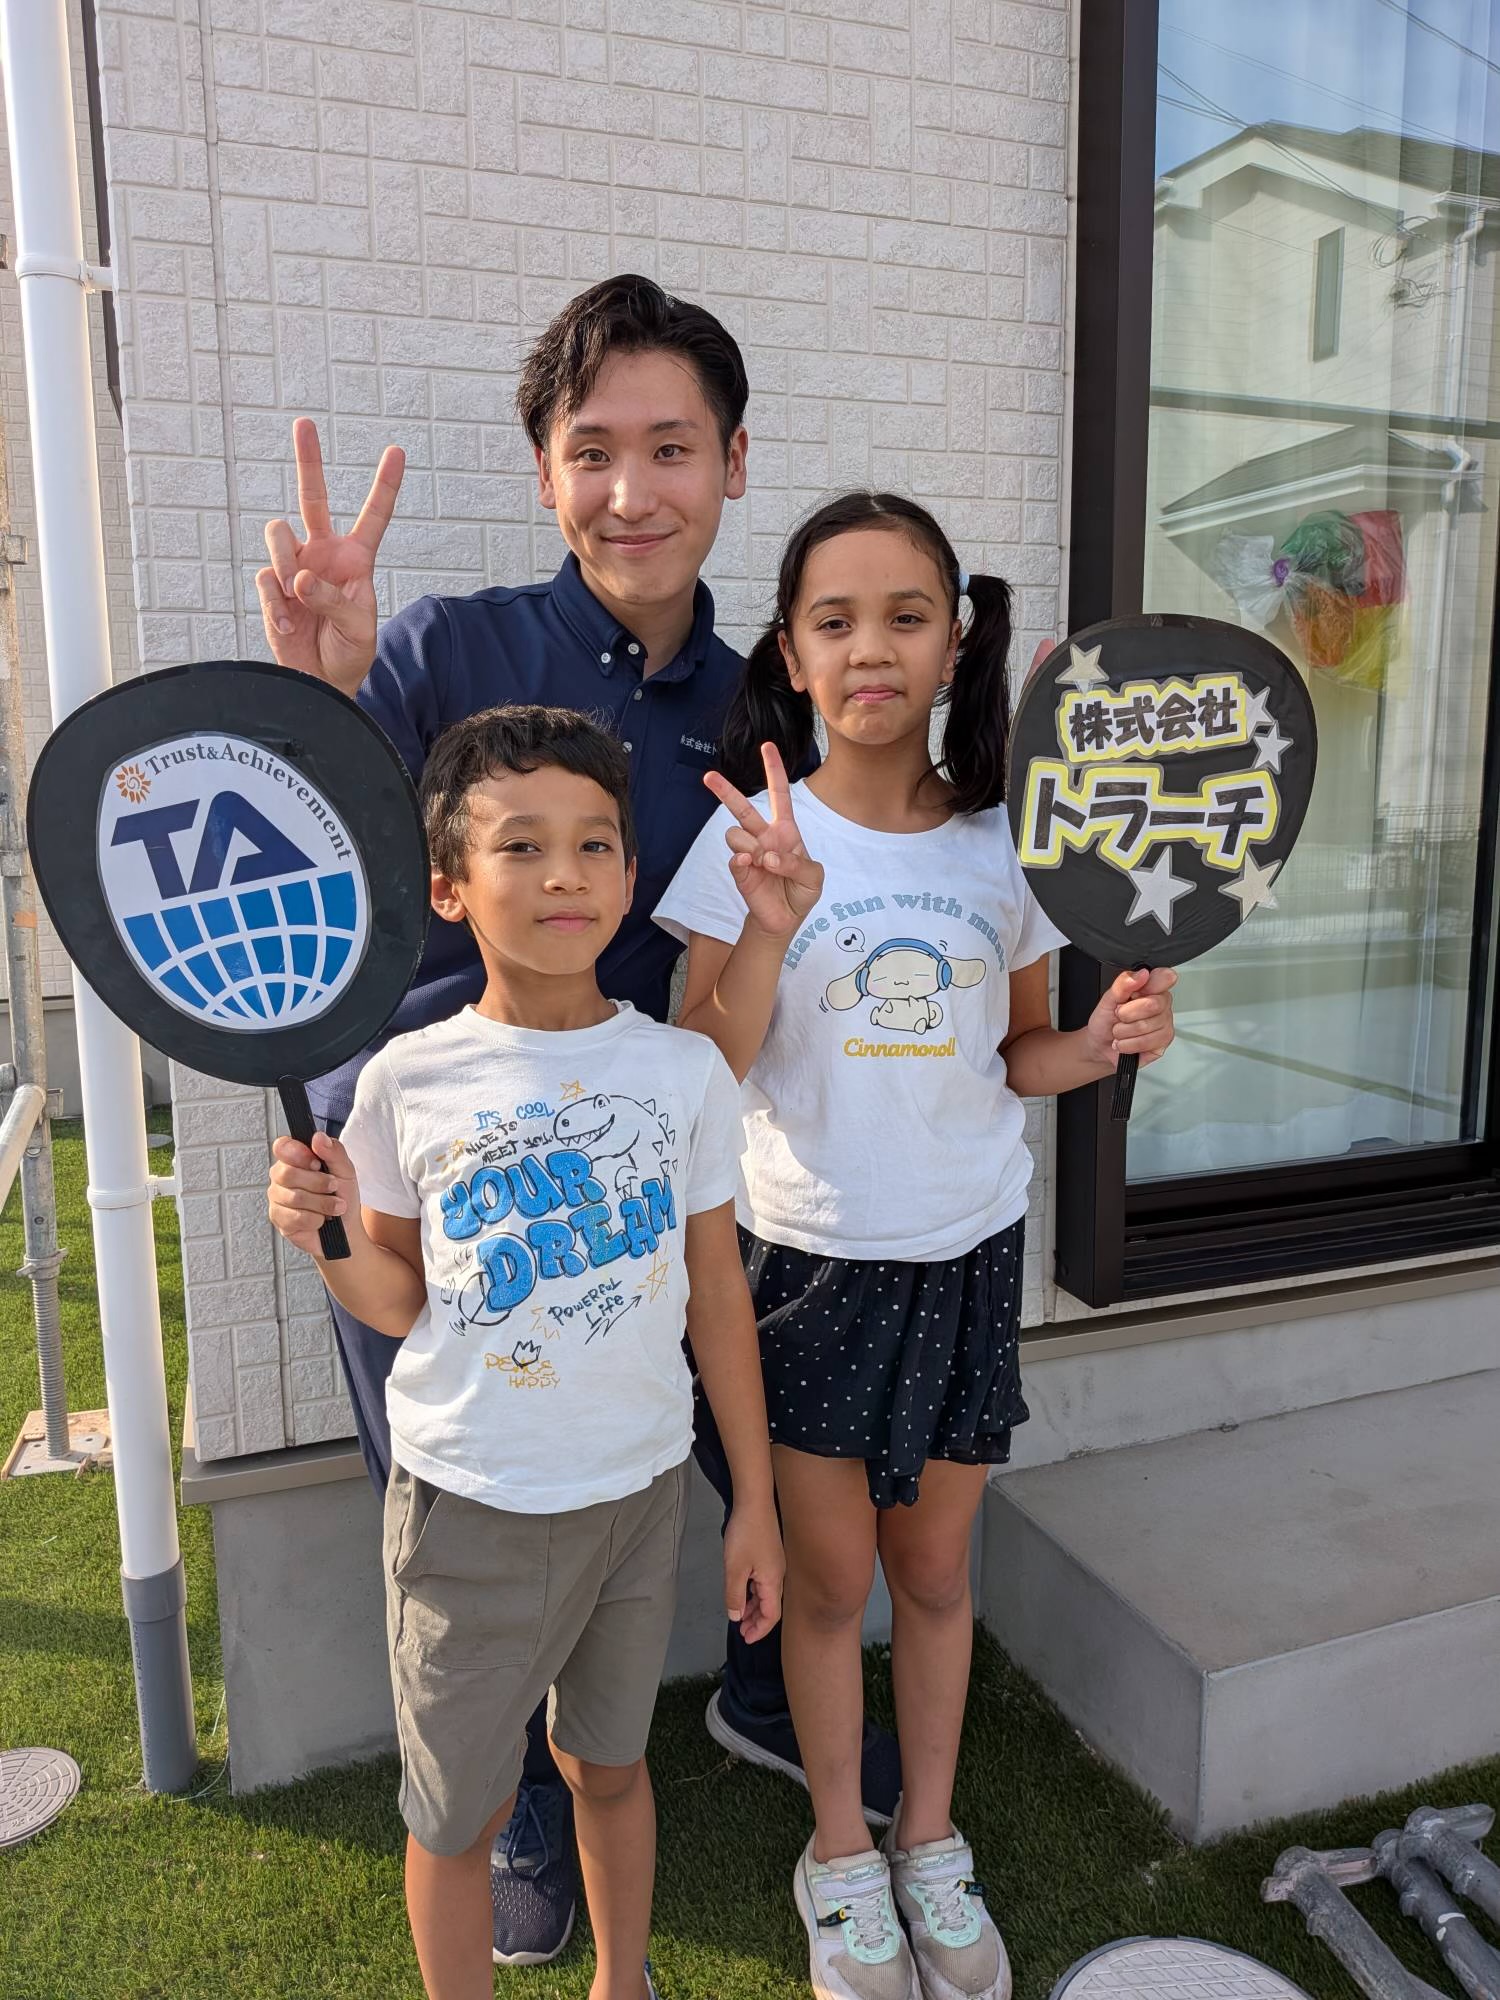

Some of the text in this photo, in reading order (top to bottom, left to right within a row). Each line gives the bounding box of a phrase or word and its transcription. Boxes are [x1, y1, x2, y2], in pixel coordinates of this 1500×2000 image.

[1068, 685, 1239, 754] 株式会社
[143, 742, 352, 861] Trust&Achievement
[1032, 776, 1265, 857] トラーチ
[110, 789, 319, 901] TA
[784, 915, 830, 970] Have
[829, 893, 886, 922] fun
[892, 891, 964, 919] with
[842, 1036, 958, 1058] Cinnamoroll
[465, 1120, 518, 1156] NICE TO
[515, 1101, 556, 1120] COOL
[481, 1139, 519, 1166] MEET
[439, 1149, 608, 1240] YOUR
[475, 1174, 679, 1314] DREAM
[508, 1375, 561, 1390] HAPPY
